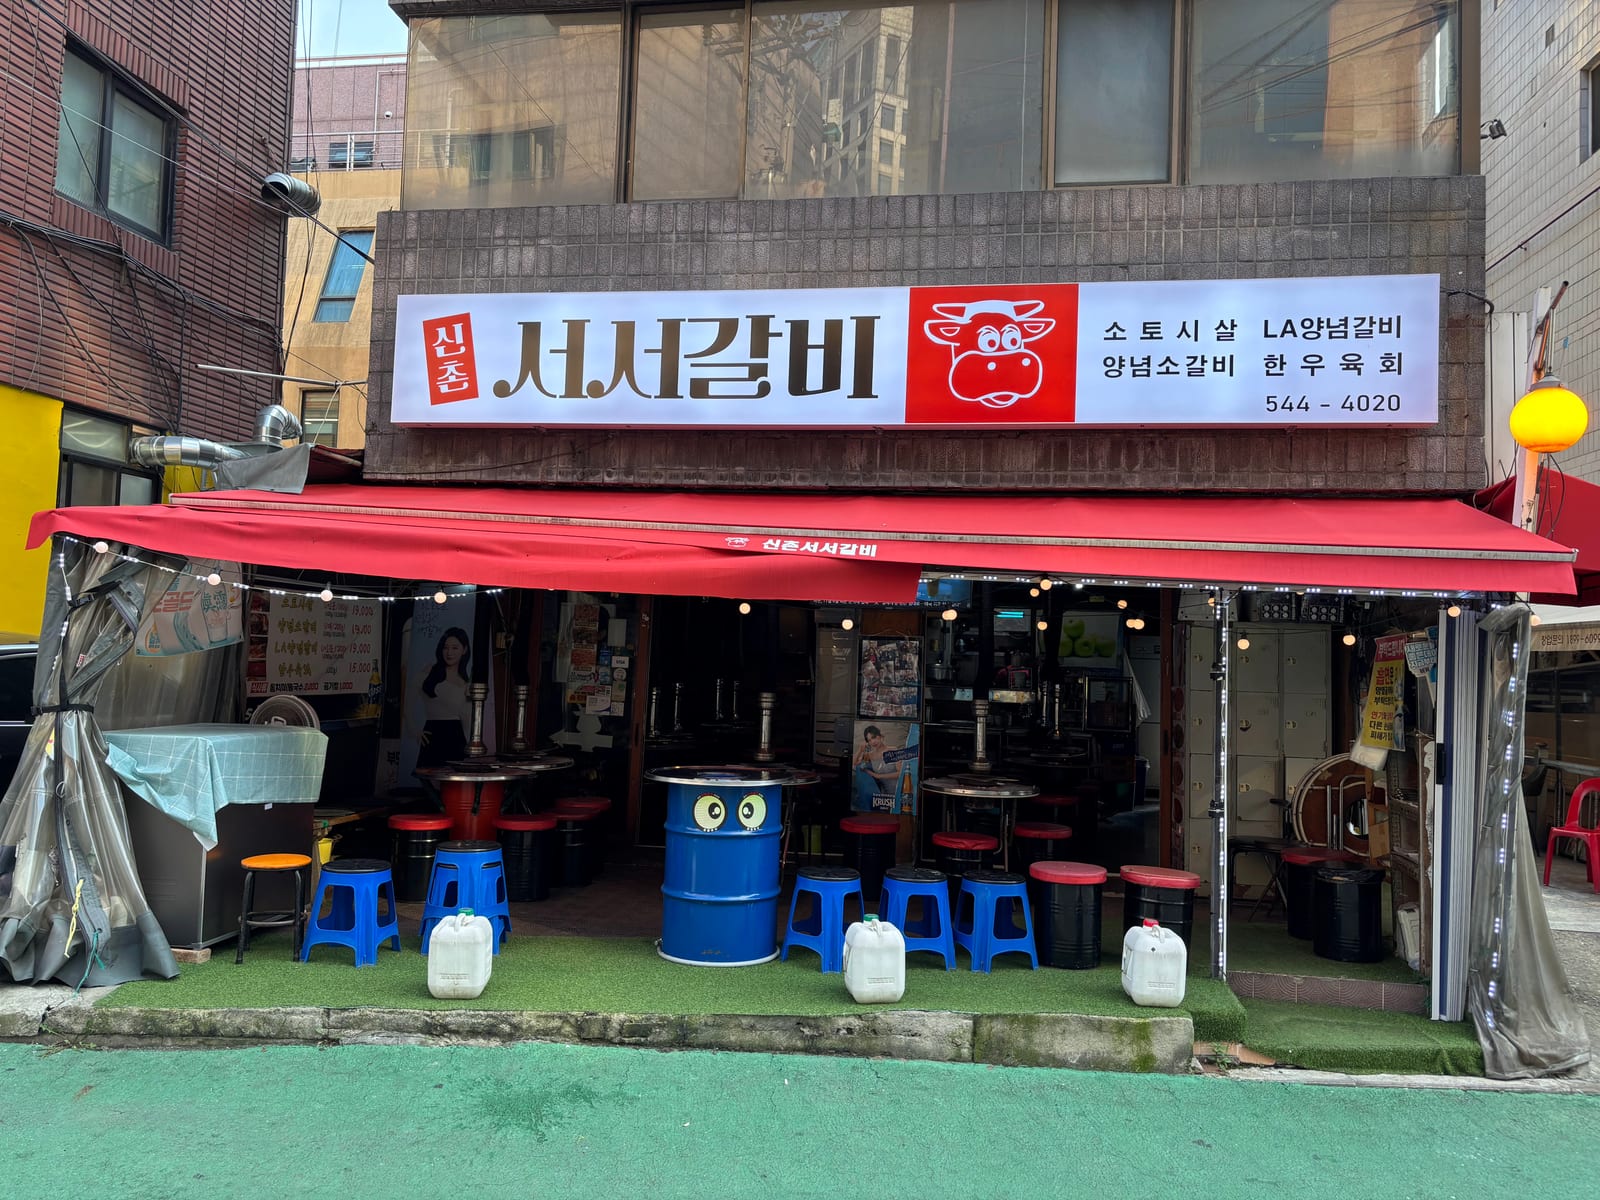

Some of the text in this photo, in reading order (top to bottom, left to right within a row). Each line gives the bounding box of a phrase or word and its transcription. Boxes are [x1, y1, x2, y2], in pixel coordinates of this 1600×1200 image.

[1263, 315, 1402, 341] LA양념갈비
[432, 321, 470, 395] 신촌
[492, 314, 881, 399] 서서갈비
[1102, 353, 1235, 378] 양념소갈비
[762, 538, 877, 557] 신촌서서갈비
[1541, 634, 1564, 646] 창업문의
[872, 797, 895, 808] KRUSH
